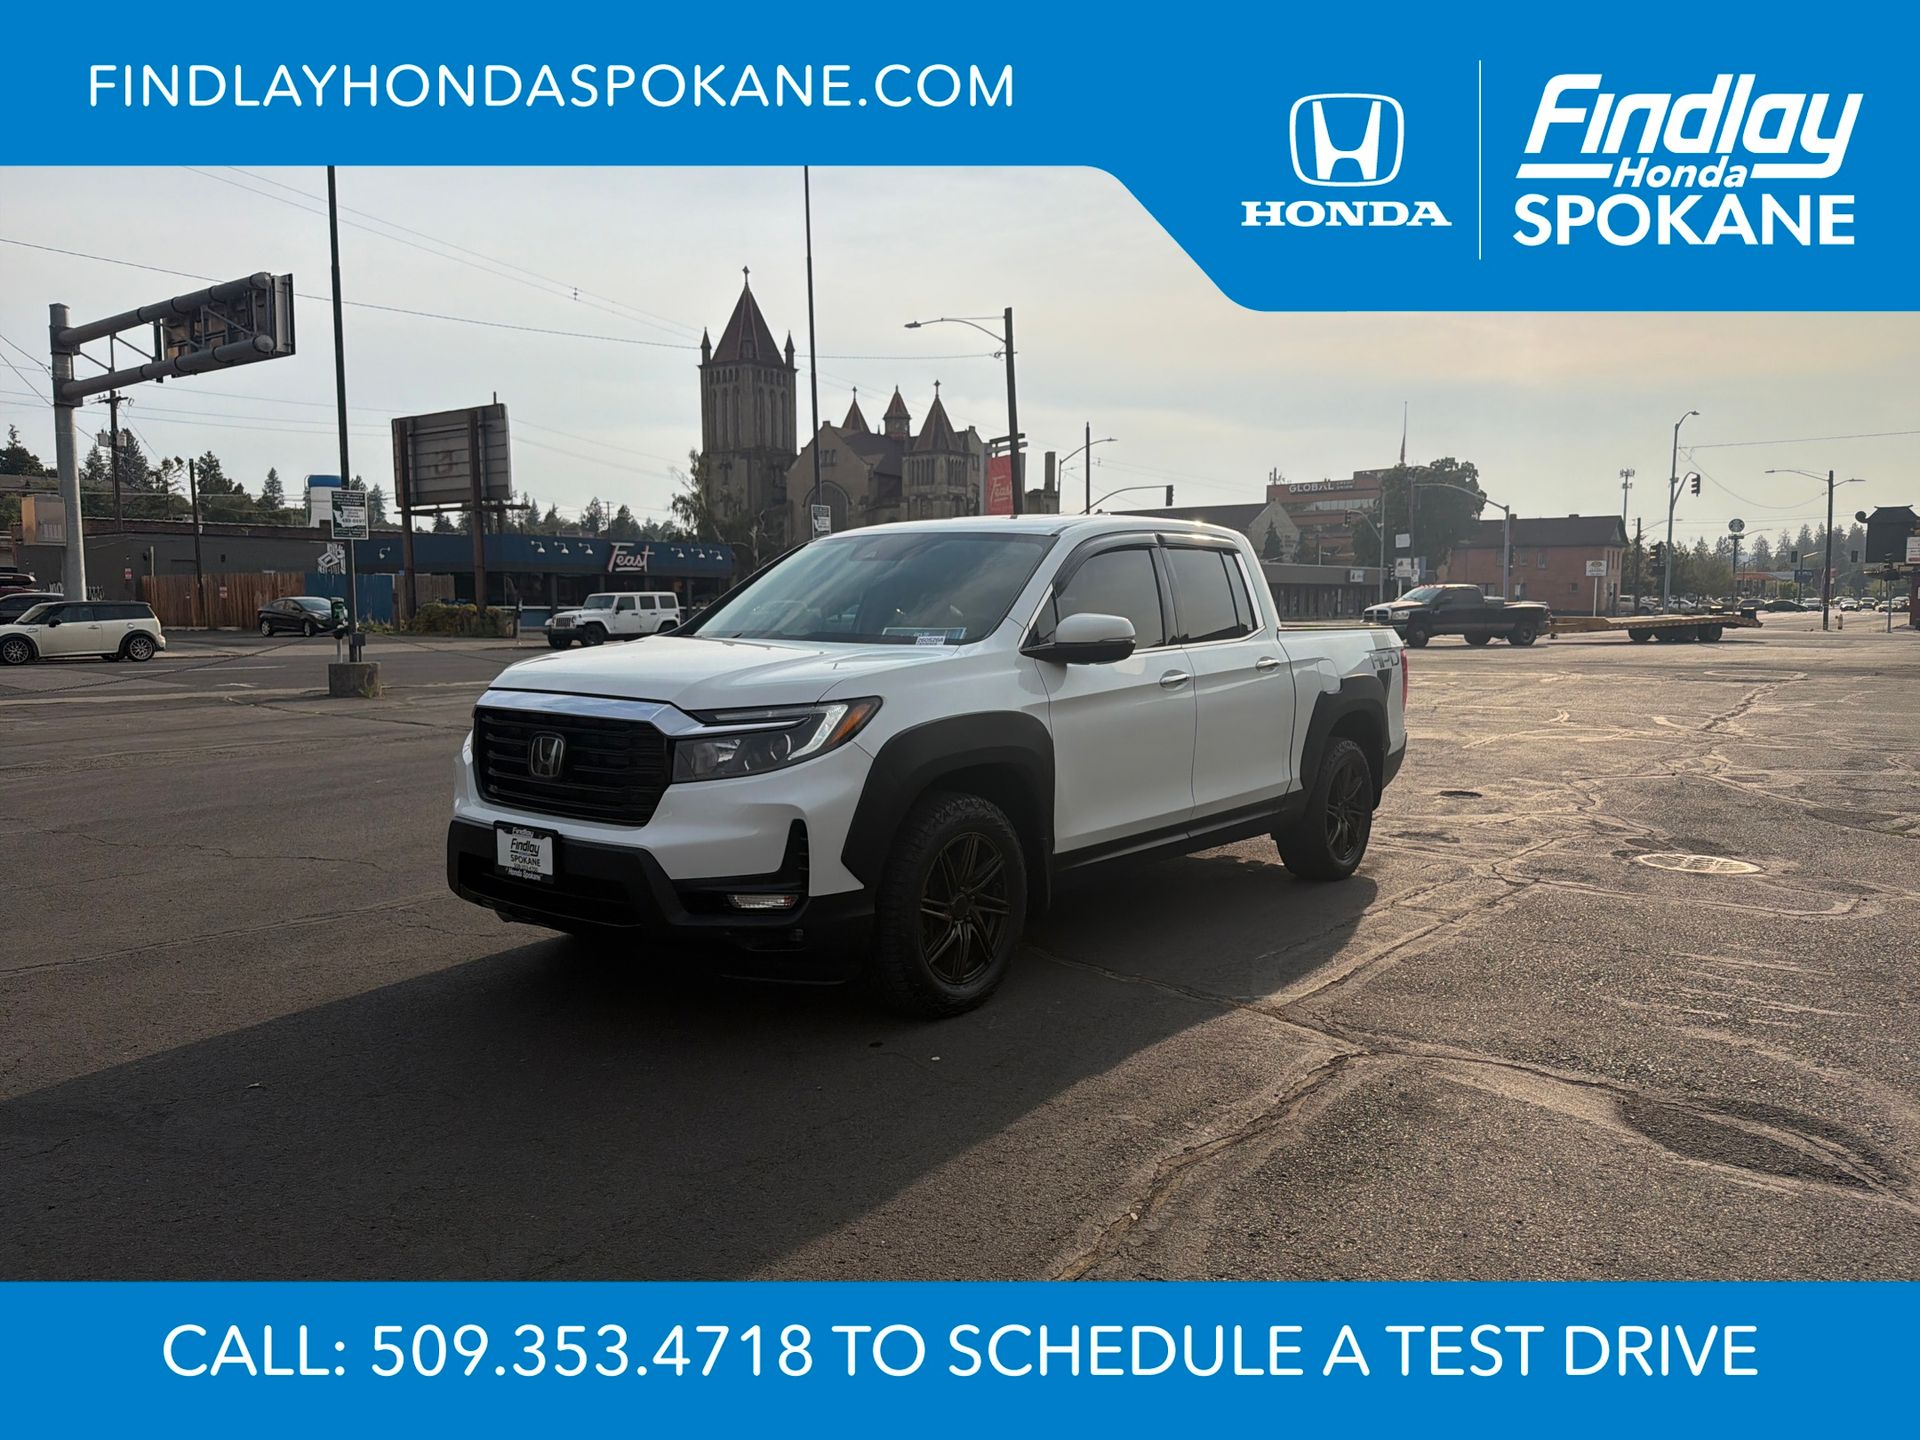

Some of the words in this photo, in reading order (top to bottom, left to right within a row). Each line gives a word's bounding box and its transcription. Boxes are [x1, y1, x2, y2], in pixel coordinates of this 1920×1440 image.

[1289, 482, 1334, 493] GLOBAL
[608, 542, 655, 572] Feast
[510, 837, 540, 857] Findlay
[510, 854, 541, 867] SPOKANE
